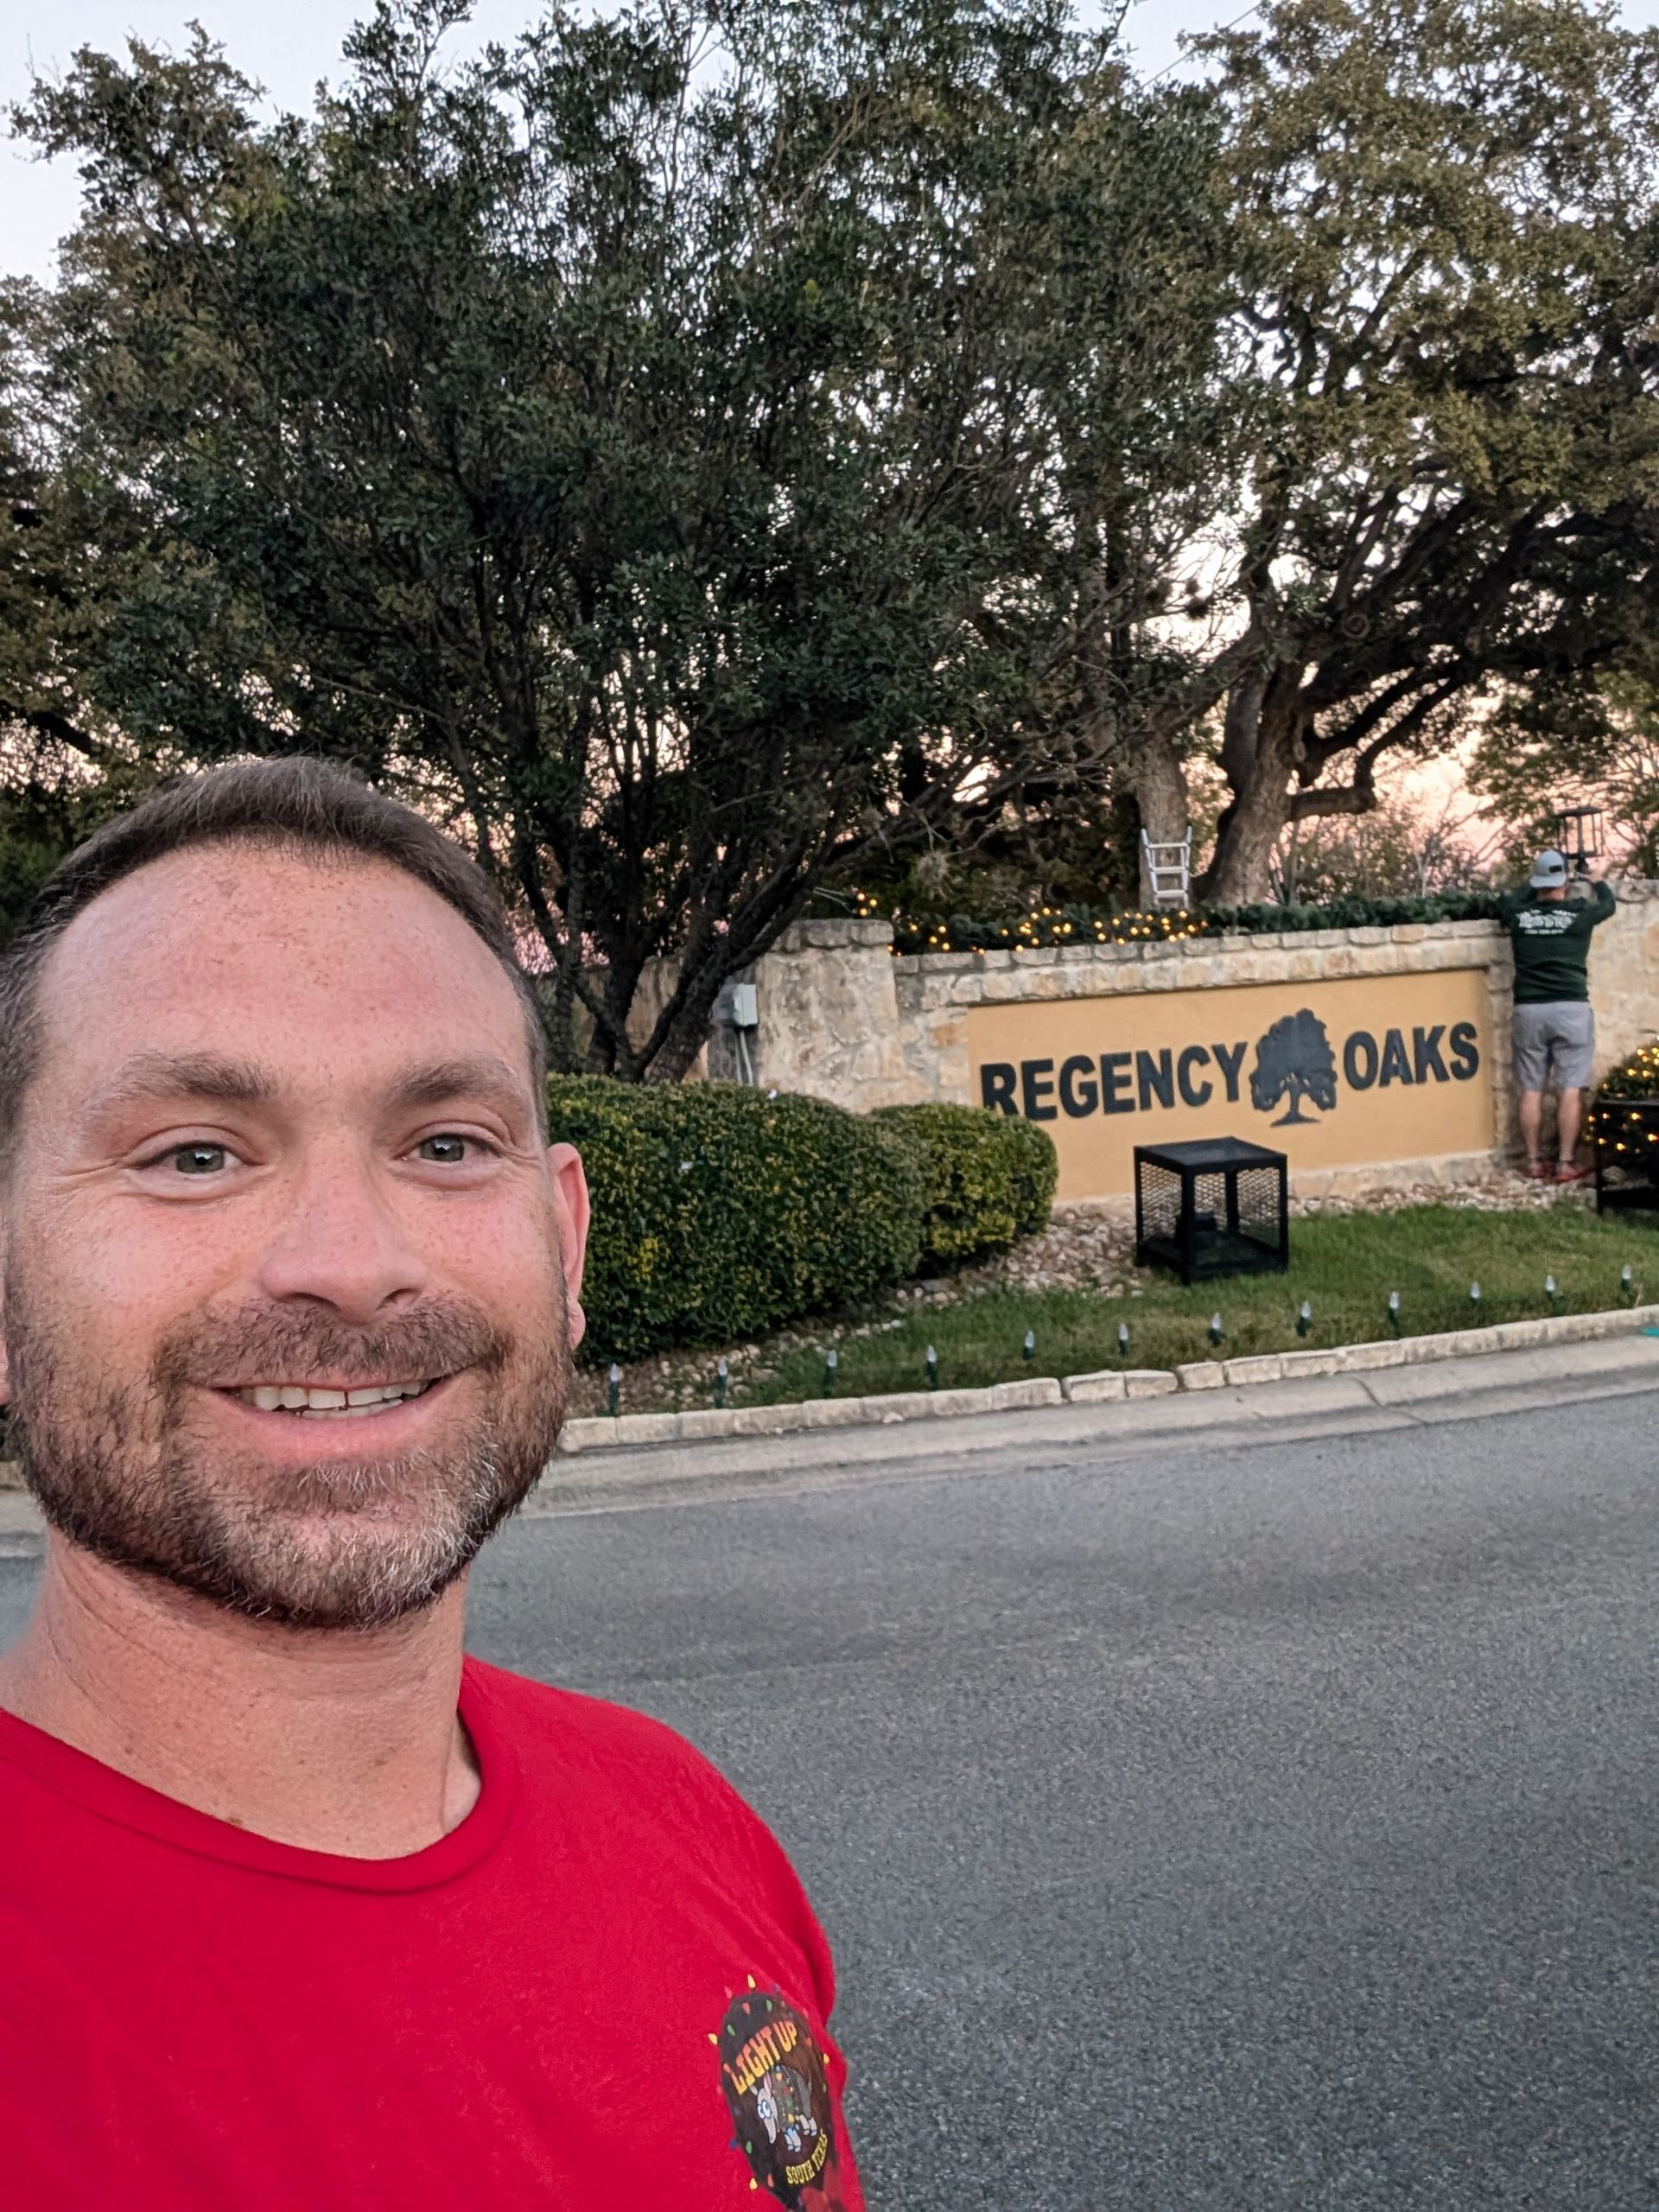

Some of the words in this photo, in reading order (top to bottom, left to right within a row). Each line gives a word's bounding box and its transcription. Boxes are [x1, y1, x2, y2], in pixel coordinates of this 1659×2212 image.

[980, 1040, 1249, 1122] REGENCY
[1343, 1020, 1480, 1091] OAKS
[723, 2025, 781, 2095] LIGHT
[772, 2019, 798, 2053] UP
[785, 2159, 816, 2184] SOUTH
